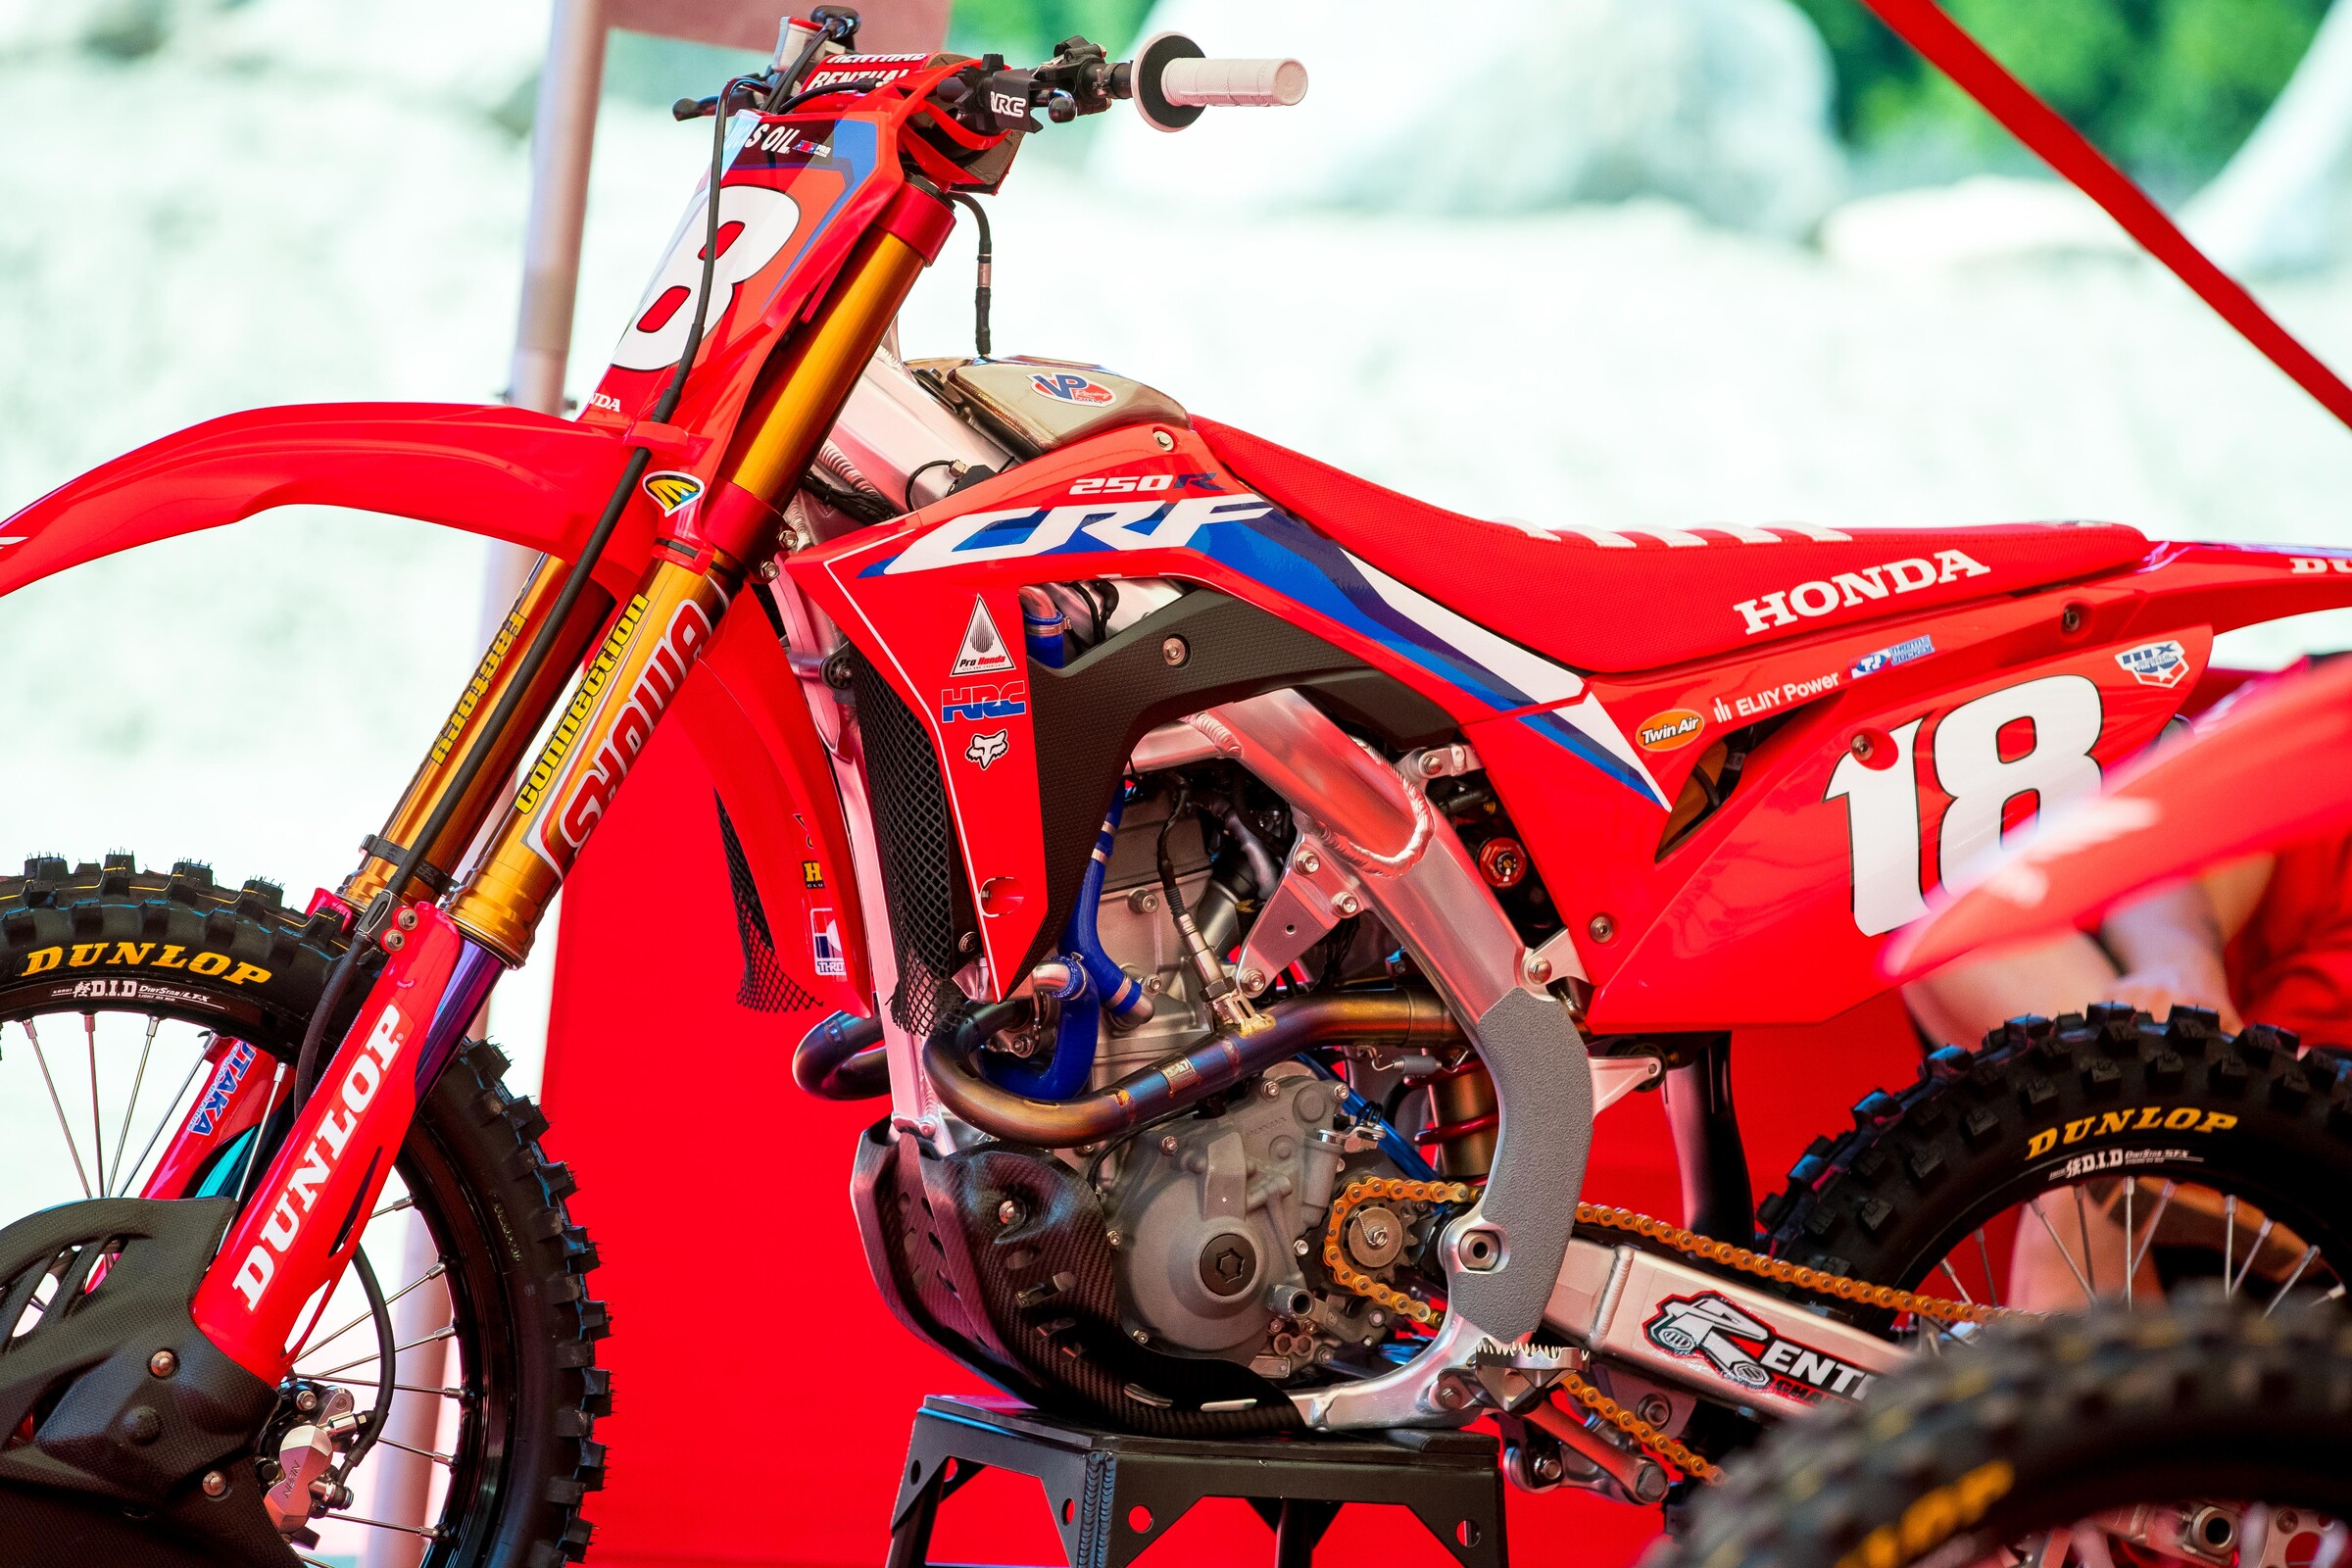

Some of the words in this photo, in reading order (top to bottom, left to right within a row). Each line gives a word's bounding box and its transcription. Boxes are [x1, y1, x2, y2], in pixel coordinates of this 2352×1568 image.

[760, 125, 801, 154] OIL
[1032, 373, 1088, 401] VP
[1069, 471, 1228, 496] 250R
[883, 493, 1274, 575] CRF
[1733, 549, 1991, 635] HONDA
[958, 659, 976, 667] Pro
[977, 655, 1006, 665] Honda
[941, 680, 1027, 723] HRC
[1783, 672, 1839, 702] Power
[559, 599, 713, 858] SHOWA
[1641, 723, 1677, 745] Twin
[1677, 716, 1700, 733] Air
[1821, 673, 2104, 938] 18
[21, 942, 272, 985] DUNLOP
[2024, 1106, 2238, 1161] DUNLOP
[231, 1004, 401, 1312] DUNLOP
